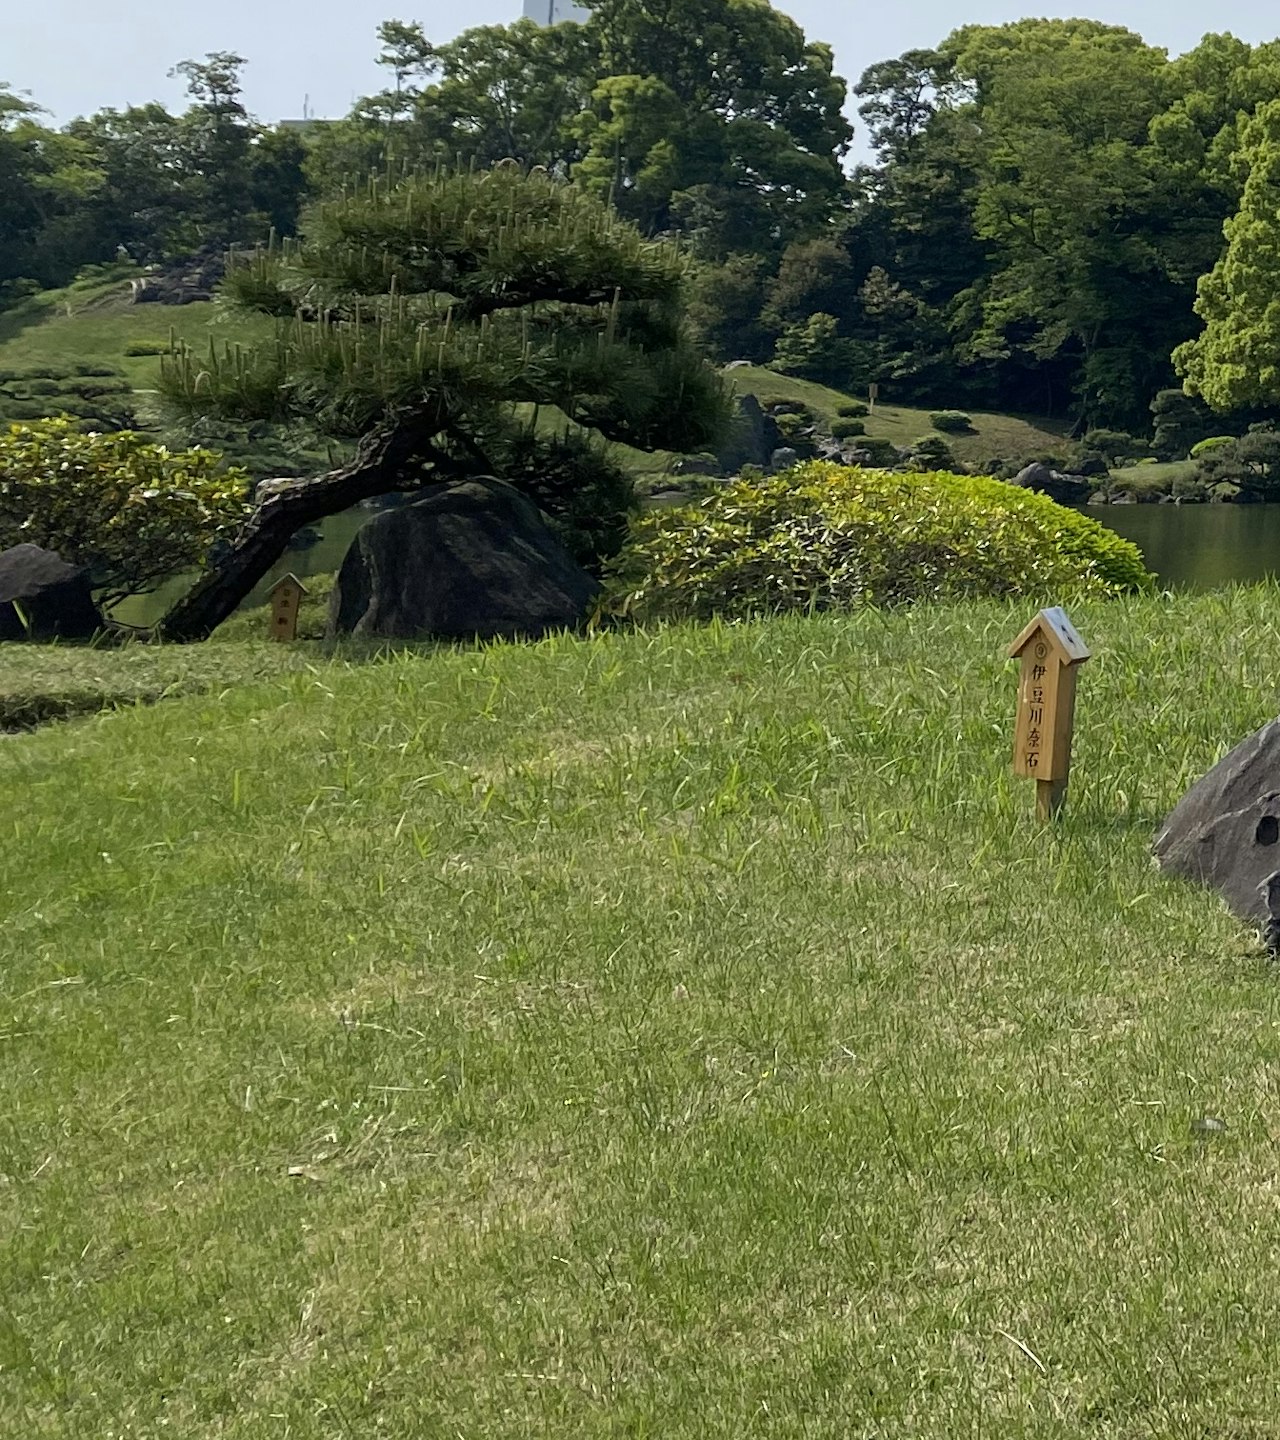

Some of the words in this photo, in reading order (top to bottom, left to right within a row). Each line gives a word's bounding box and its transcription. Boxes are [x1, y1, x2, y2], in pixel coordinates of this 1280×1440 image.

[1026, 664, 1047, 768] 伊豆川奈石
